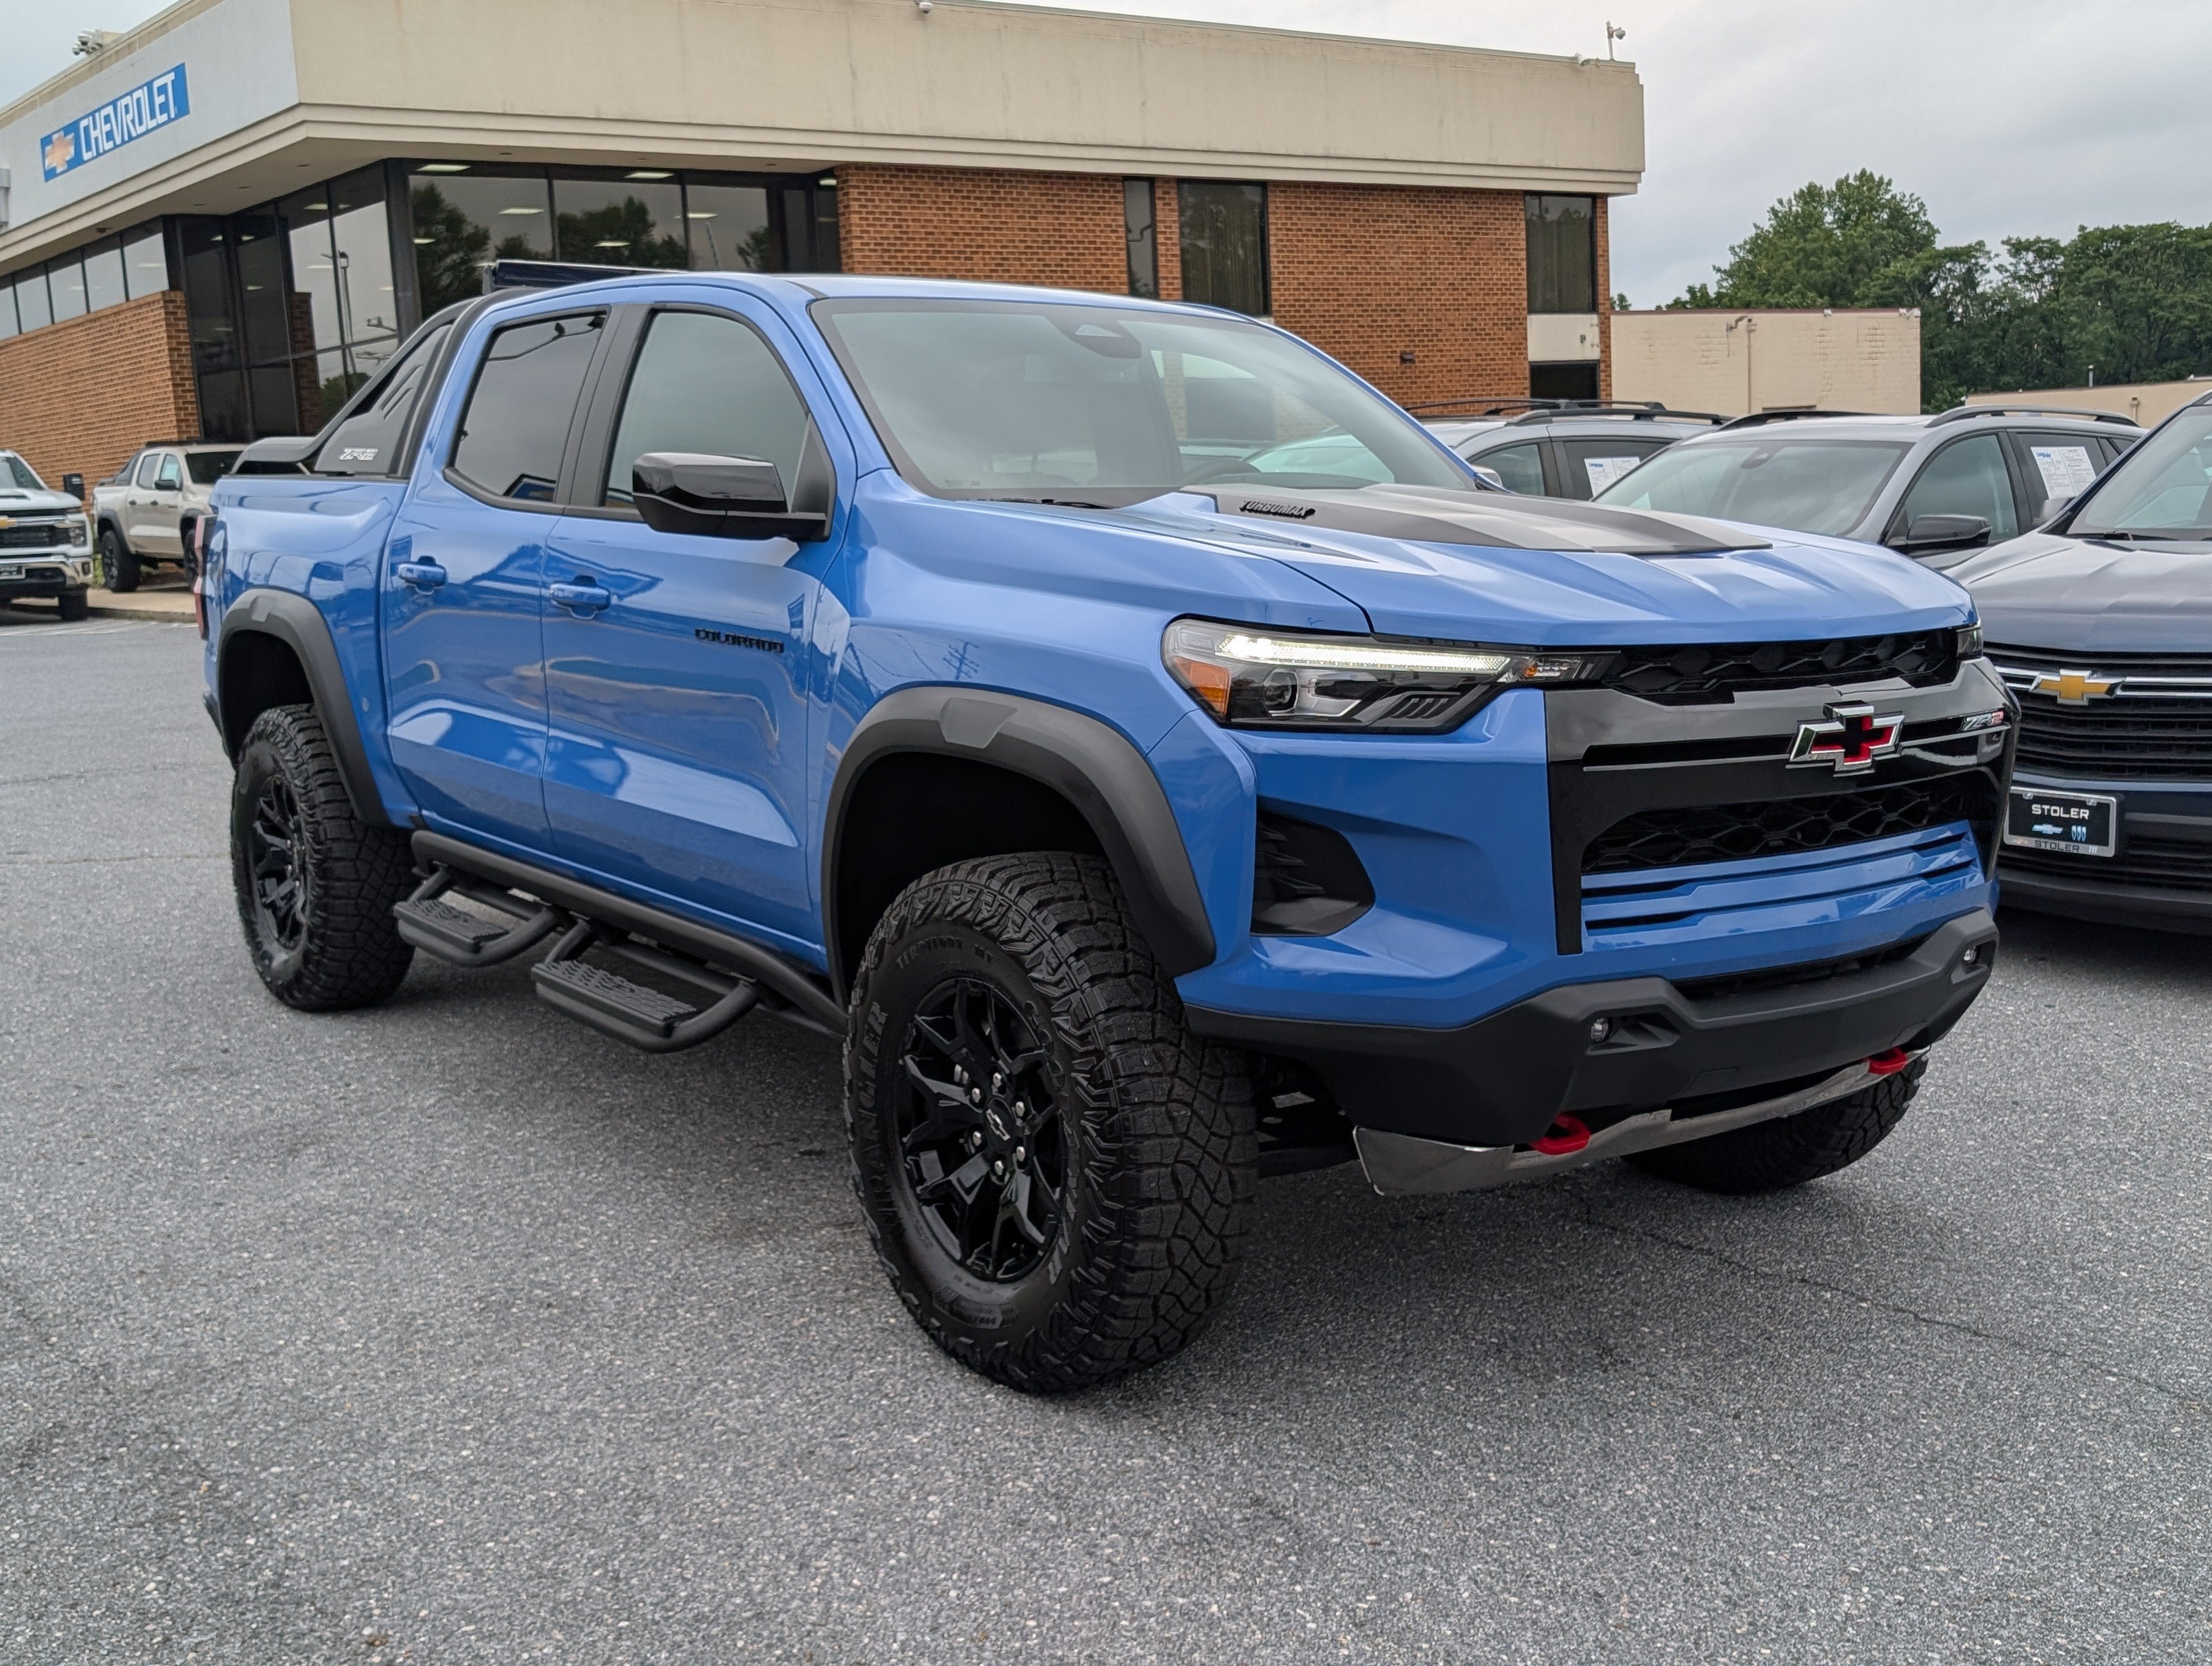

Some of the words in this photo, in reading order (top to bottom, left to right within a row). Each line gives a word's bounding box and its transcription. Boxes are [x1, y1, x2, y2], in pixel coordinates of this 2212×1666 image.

[79, 71, 175, 161] CHEVROLET
[1239, 499, 1314, 519] TURBOMAX
[694, 627, 785, 653] COLORADO
[1963, 711, 2004, 731] ZR2
[2031, 804, 2089, 820] STOLER
[2034, 840, 2080, 854] STOLER
